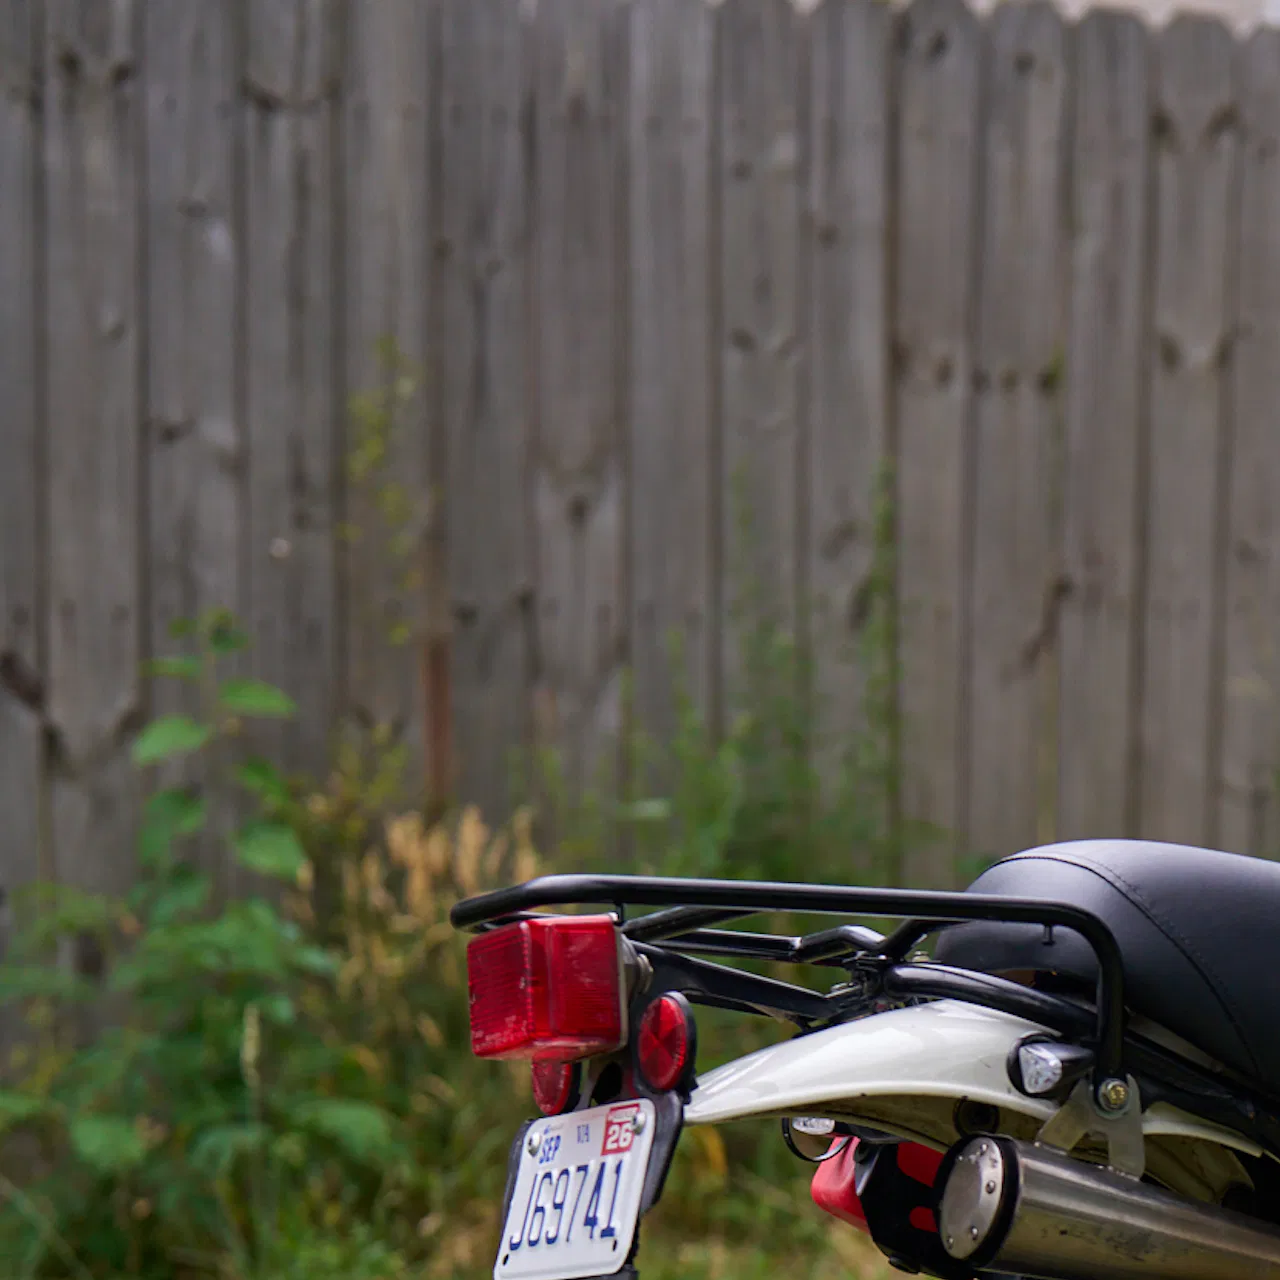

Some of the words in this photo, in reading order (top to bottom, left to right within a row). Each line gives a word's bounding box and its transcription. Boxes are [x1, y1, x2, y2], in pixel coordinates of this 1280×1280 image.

[539, 1134, 561, 1164] SEP
[605, 1121, 633, 1151] 26
[509, 1159, 624, 1251] J69741
